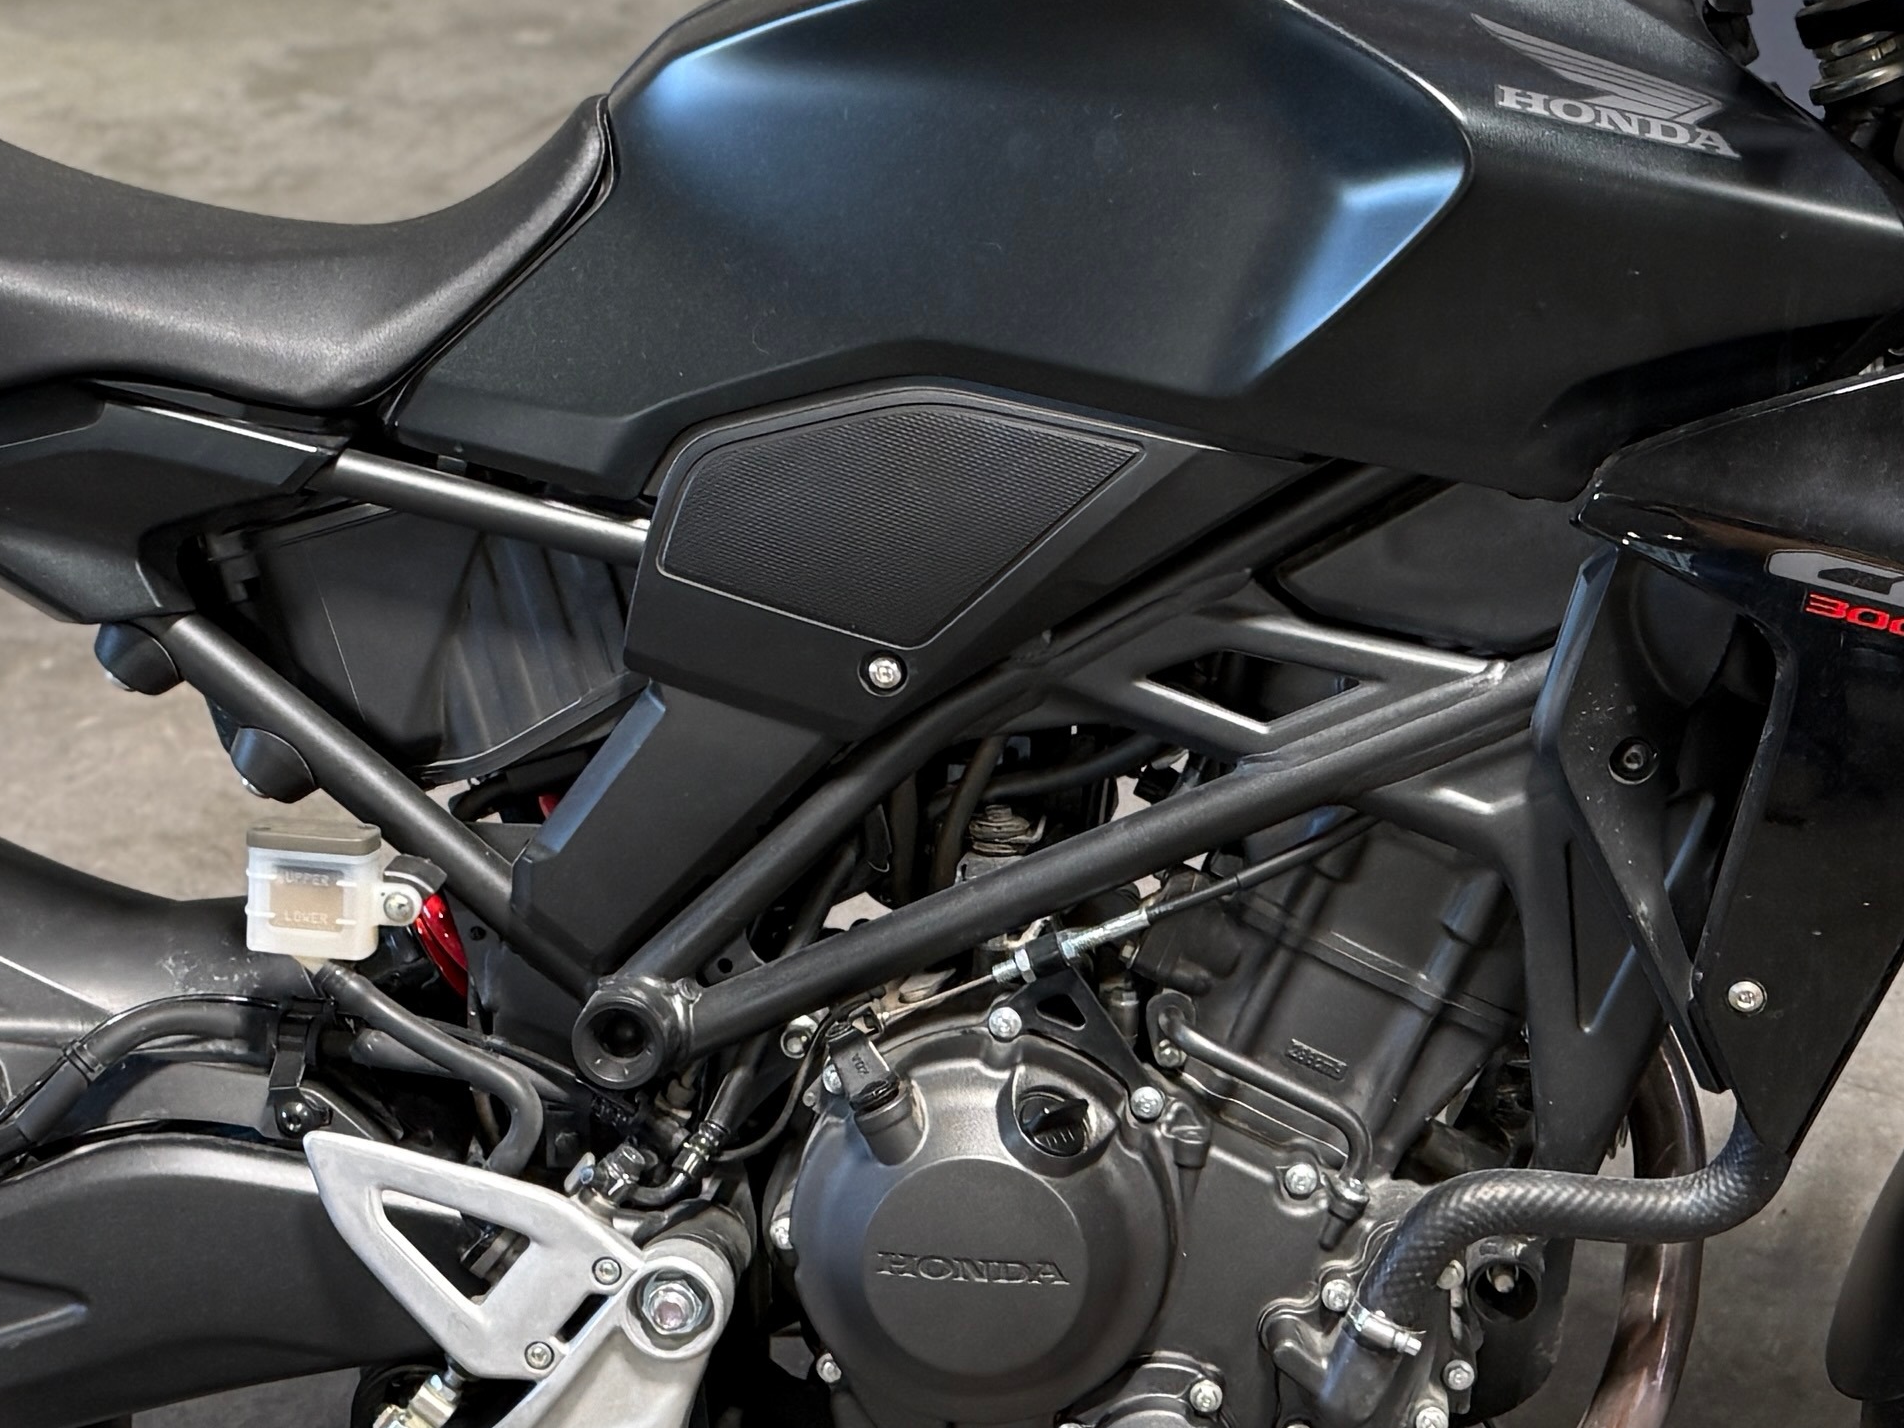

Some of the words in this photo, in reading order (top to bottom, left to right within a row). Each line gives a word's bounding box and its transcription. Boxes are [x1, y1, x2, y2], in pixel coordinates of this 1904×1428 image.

[1494, 84, 1742, 160] HONDA
[283, 910, 329, 926] LOWER
[875, 1250, 1071, 1286] HONDA
